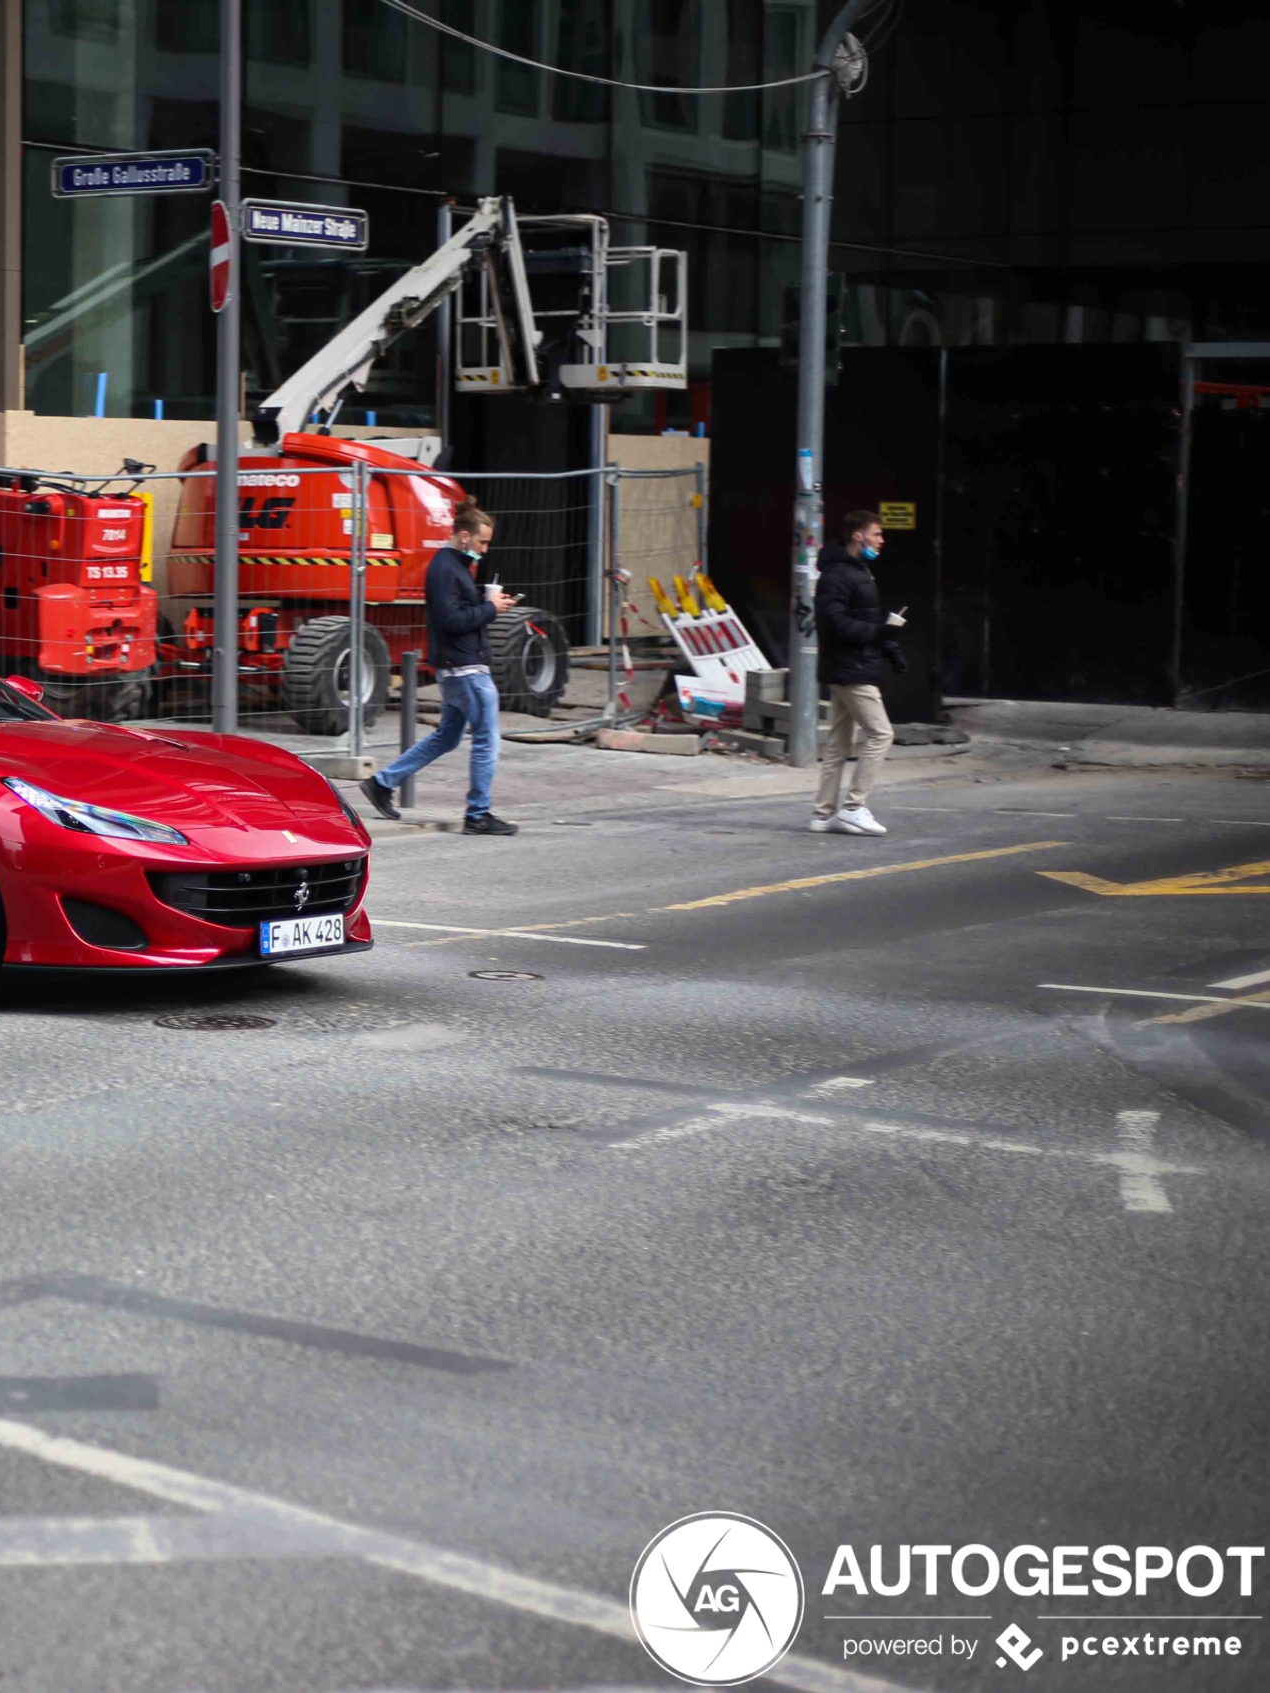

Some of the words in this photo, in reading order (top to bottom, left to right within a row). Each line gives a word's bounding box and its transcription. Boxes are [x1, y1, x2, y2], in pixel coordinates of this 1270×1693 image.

[73, 167, 110, 186] Große
[112, 162, 191, 184] Gallusstraße
[252, 210, 279, 230] Neue
[281, 213, 323, 234] Mainzer
[324, 217, 356, 239] Straße
[86, 566, 101, 579] TS
[271, 925, 281, 948] F
[292, 922, 312, 946] AK
[315, 918, 342, 942] 428
